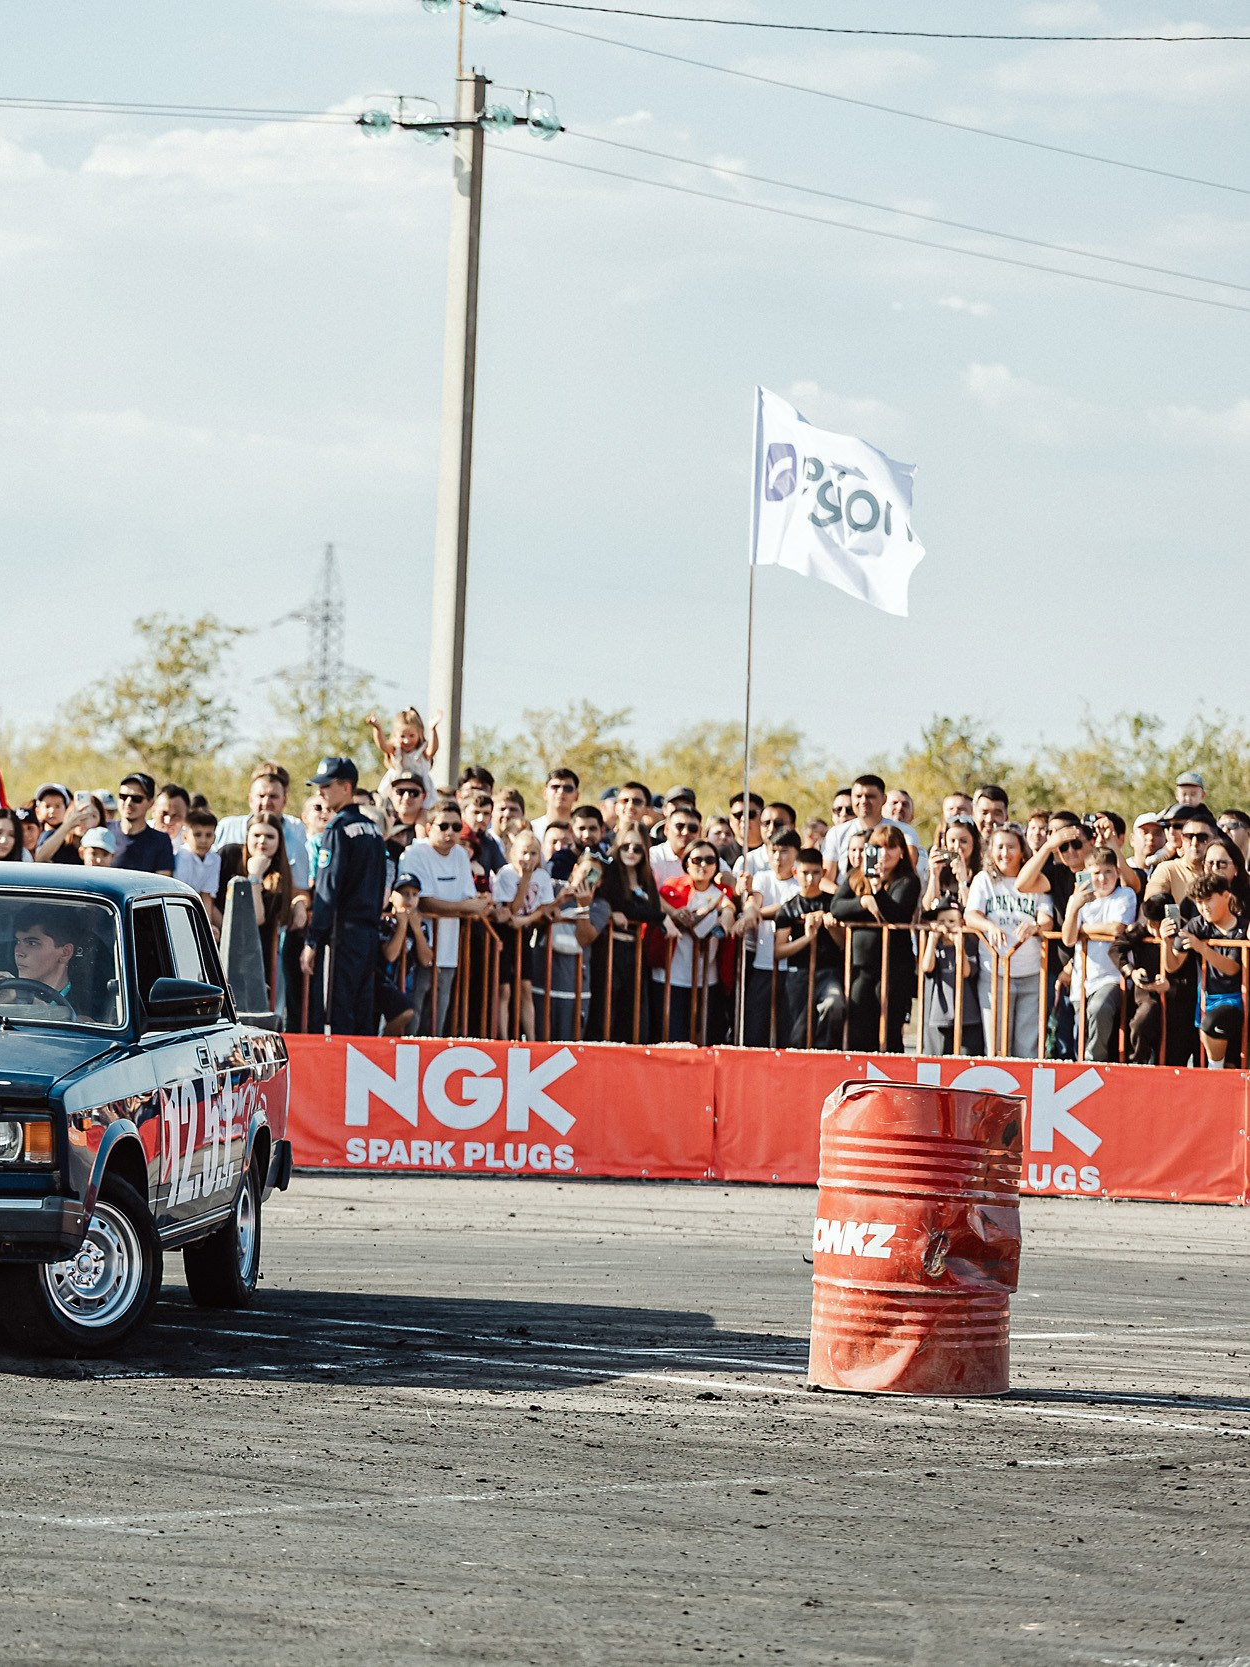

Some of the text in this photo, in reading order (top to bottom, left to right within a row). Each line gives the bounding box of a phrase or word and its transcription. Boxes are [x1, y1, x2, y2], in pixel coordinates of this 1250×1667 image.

[344, 1042, 578, 1137] NGK
[345, 1137, 575, 1171] SPARK PLUGS
[1019, 1162, 1101, 1193] UGS
[812, 1216, 897, 1260] OWKZ
